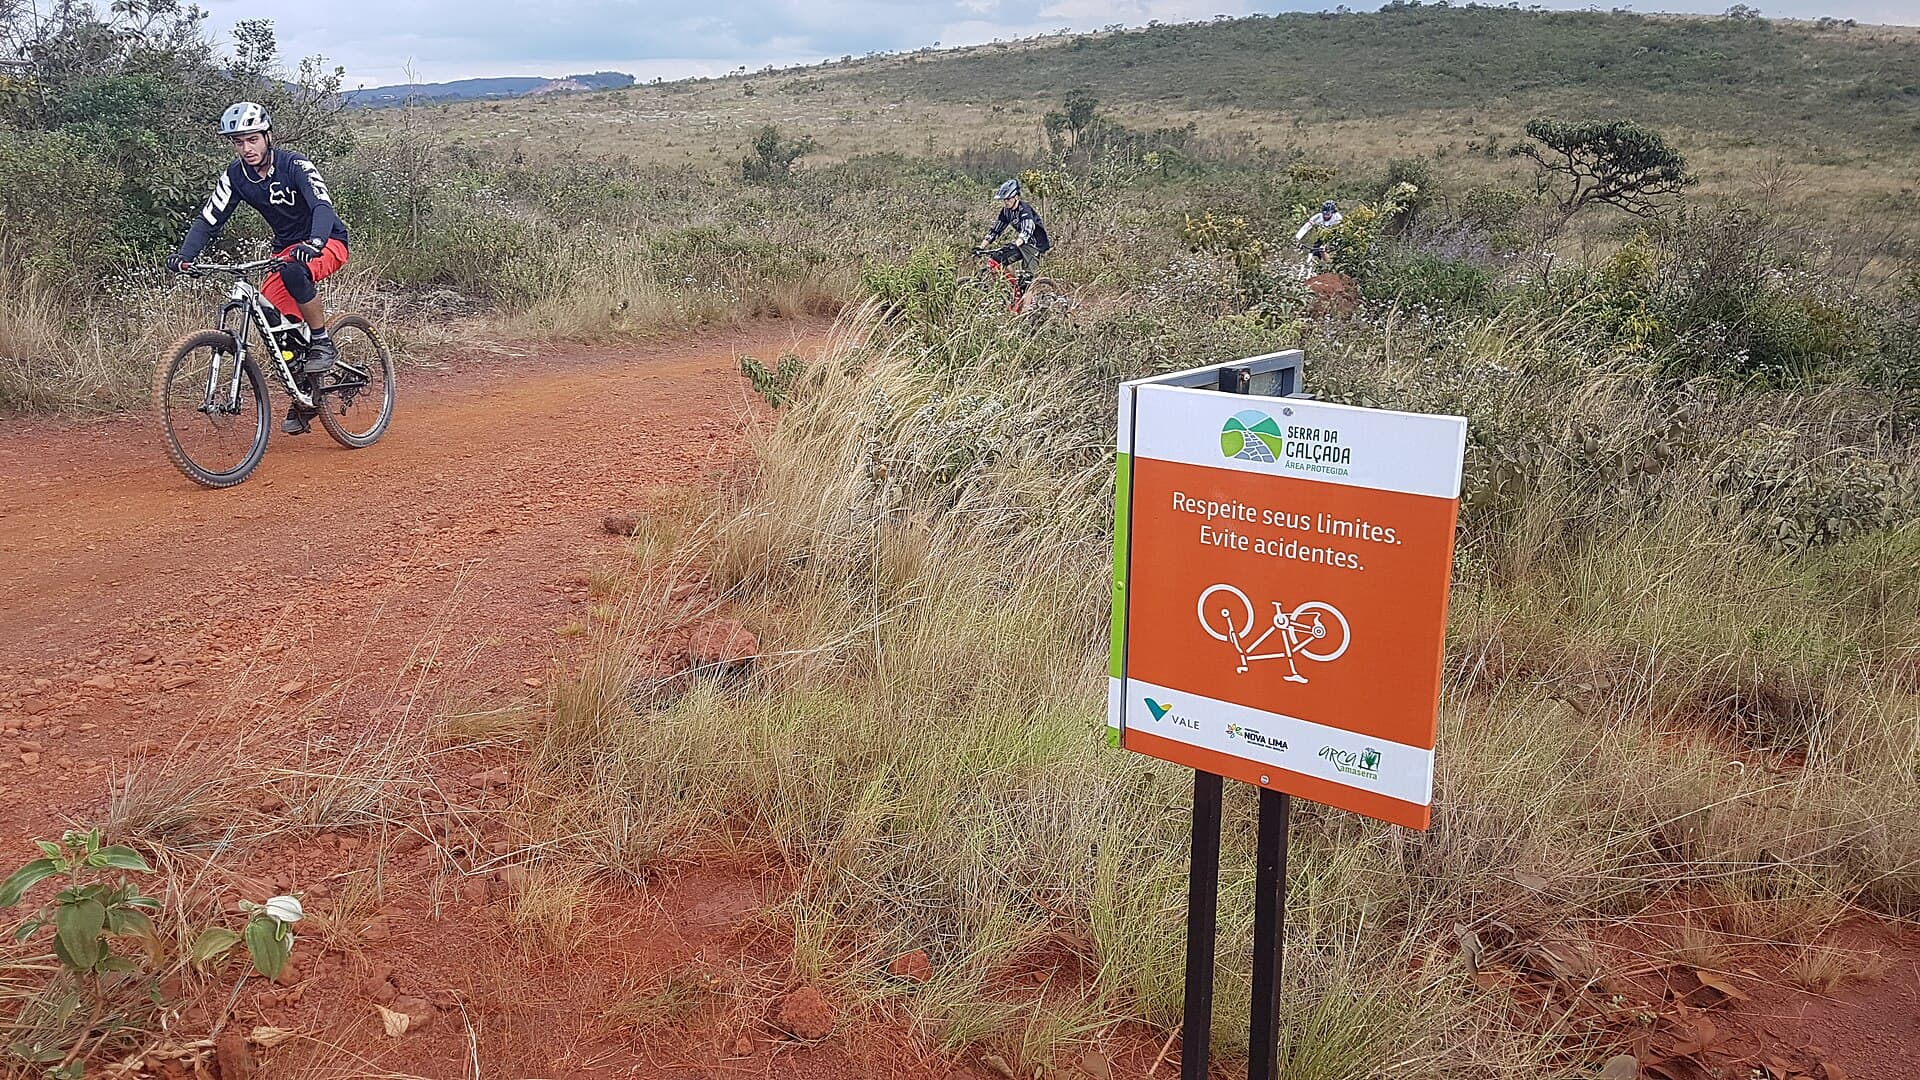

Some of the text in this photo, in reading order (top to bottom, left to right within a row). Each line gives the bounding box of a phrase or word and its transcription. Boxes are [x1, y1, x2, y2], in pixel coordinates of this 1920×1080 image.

[1287, 425, 1338, 443] SERRA DA
[1286, 441, 1350, 465] CALÇADA
[1285, 459, 1349, 476] ÁREA PROTEGIDA
[1172, 491, 1403, 545] Respeite seus limites.
[1199, 525, 1365, 571] Evite acidentes.
[1171, 714, 1200, 730] VALE
[1244, 731, 1266, 744] NOVA
[1268, 737, 1288, 750] LIMA
[1340, 765, 1378, 780] amaserra
